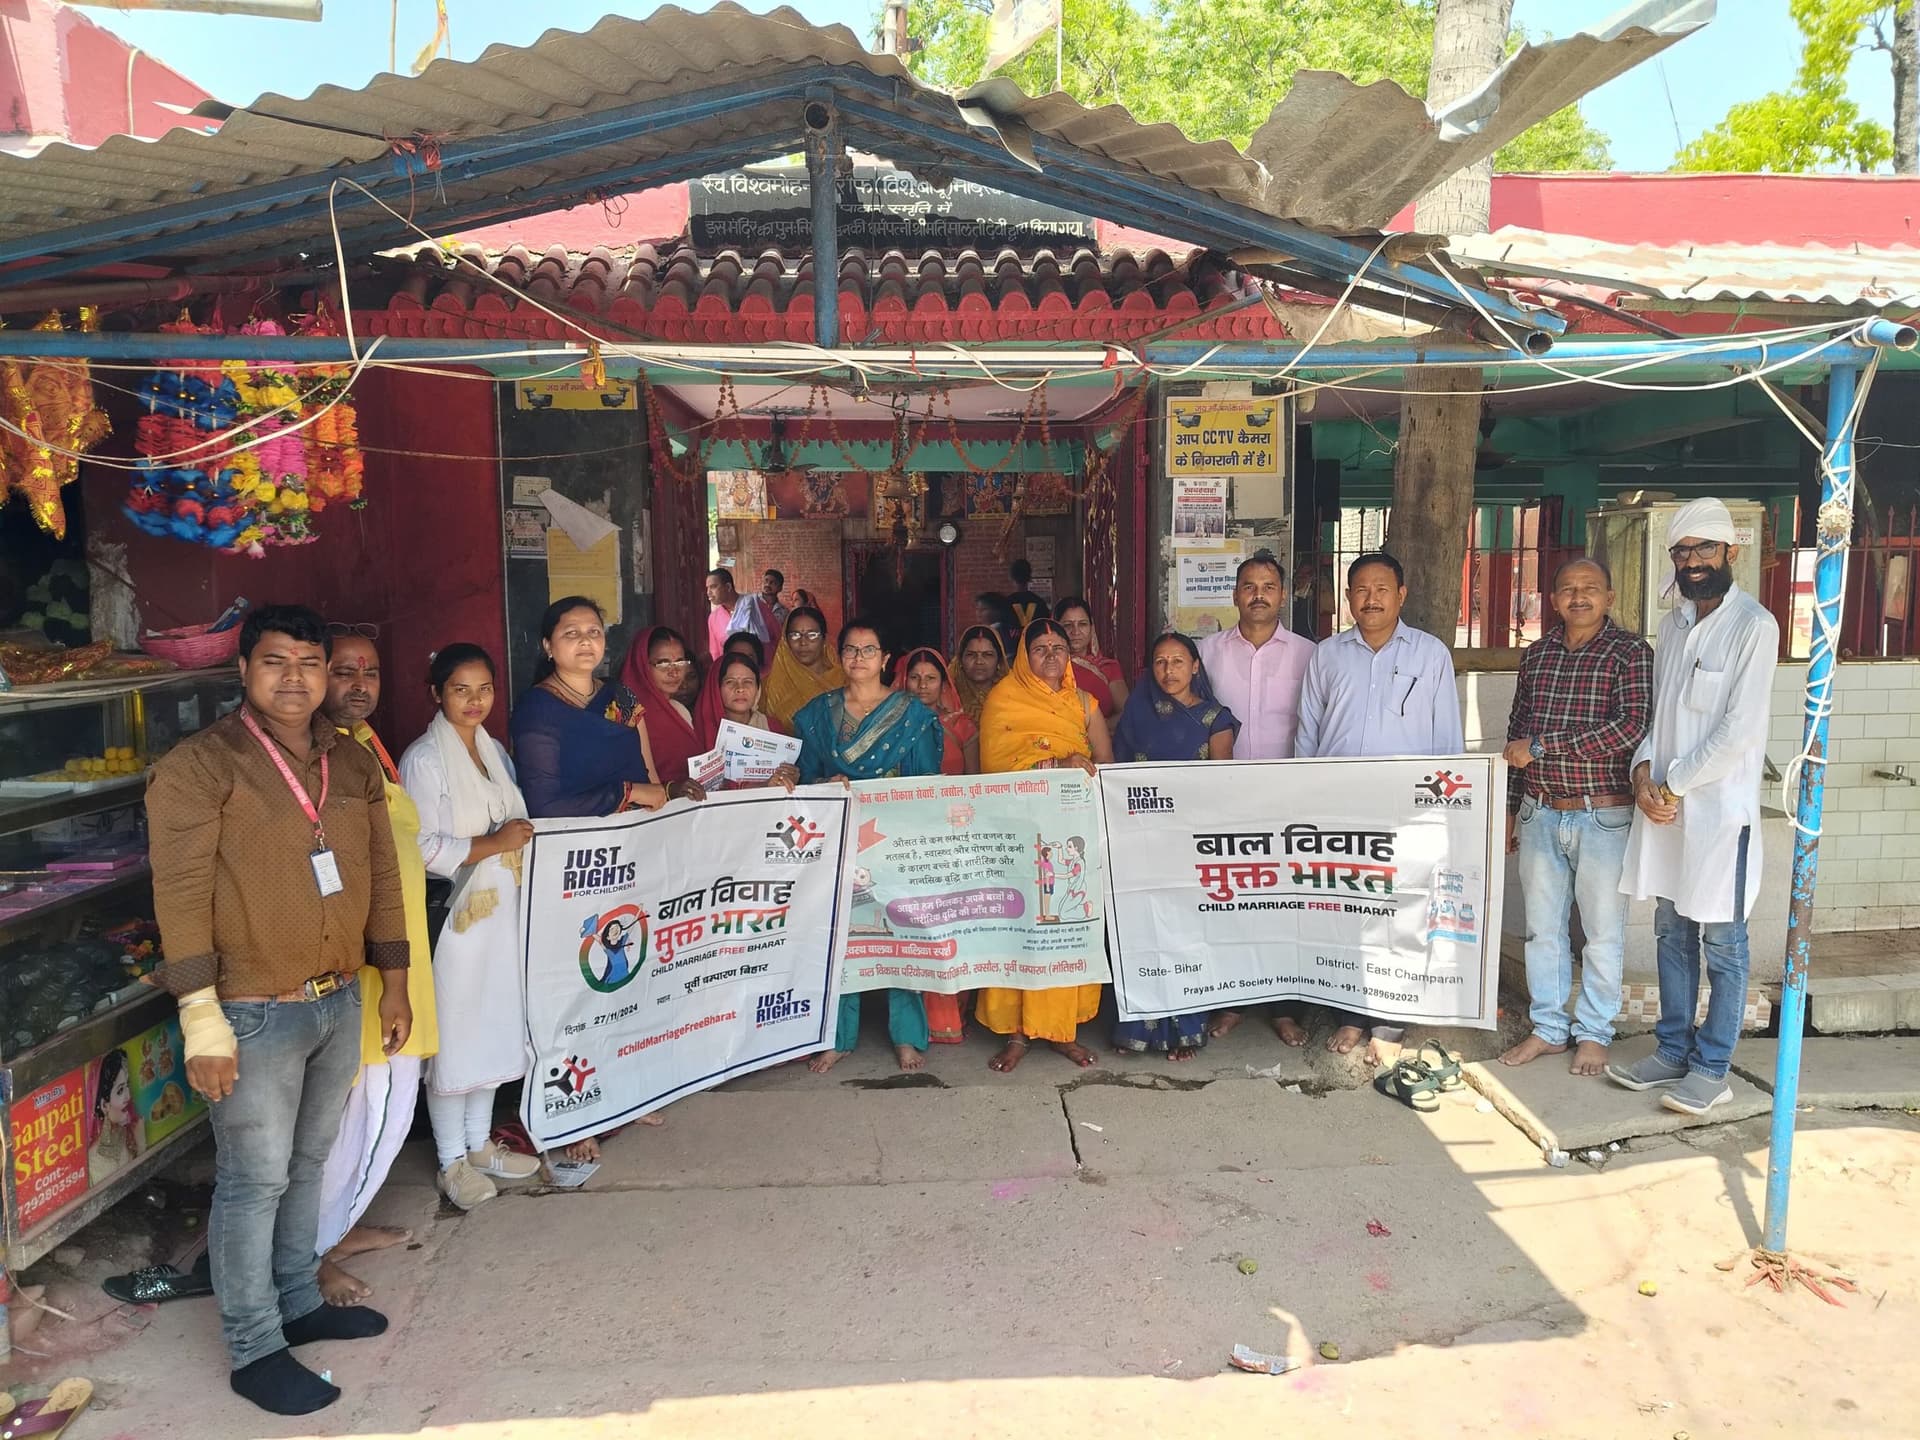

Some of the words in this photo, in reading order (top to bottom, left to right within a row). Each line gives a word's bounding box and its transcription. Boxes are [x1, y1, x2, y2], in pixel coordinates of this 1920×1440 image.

[887, 201, 932, 216] स्मृति
[936, 201, 952, 214] में
[1176, 434, 1200, 445] आप
[1203, 430, 1234, 444] CCTV
[1237, 428, 1271, 444] कैमरा
[1175, 451, 1188, 466] के
[1191, 450, 1240, 466] निगरानी
[1243, 450, 1255, 466] में
[1127, 786, 1158, 798] JUST
[1128, 797, 1174, 810] RIGHTS
[1414, 797, 1472, 806] PRAYAS
[765, 849, 822, 859] PRAYAS
[1192, 832, 1274, 856] बाल
[1280, 823, 1397, 862] विवाह
[564, 846, 621, 870] JUST
[563, 861, 636, 891] RIGHTS
[1195, 862, 1281, 902] मुक्त
[1287, 861, 1398, 894] भारत
[574, 890, 591, 898] FOR
[593, 884, 632, 895] CHILDREN
[658, 888, 706, 920] बाल
[711, 876, 795, 905] विवाह
[1198, 903, 1235, 912] CHILD
[1238, 901, 1305, 911] MARRIAGE
[1308, 902, 1341, 911] FREE
[1344, 904, 1397, 918] BHARAT
[653, 916, 706, 964] मुक्त
[711, 905, 790, 934] भारत
[651, 963, 674, 977] CHILD
[675, 950, 718, 969] MARRIAGE
[718, 946, 746, 956] FREE
[747, 938, 786, 952] BHARAT
[702, 965, 737, 985] चम्पारण
[740, 963, 769, 975] बिहार
[1138, 967, 1171, 977] State-
[1174, 963, 1202, 974] Bihar
[1316, 956, 1359, 971] District-
[1366, 963, 1391, 977] East
[1395, 968, 1464, 985] Champaran
[757, 988, 794, 1009] JUST
[1183, 985, 1215, 995] Prayas
[1217, 980, 1236, 991] JAC
[1239, 977, 1273, 988] Society
[1276, 975, 1315, 985] Helpline
[1362, 987, 1419, 1003] 9289692023
[594, 1003, 638, 1024] 27/11/2024
[756, 999, 810, 1023] RIGHTS
[617, 1009, 737, 1058] #ChildMarriageFreeBharat
[545, 1087, 601, 1112] PRAYAS
[14, 1118, 83, 1186] Steel
